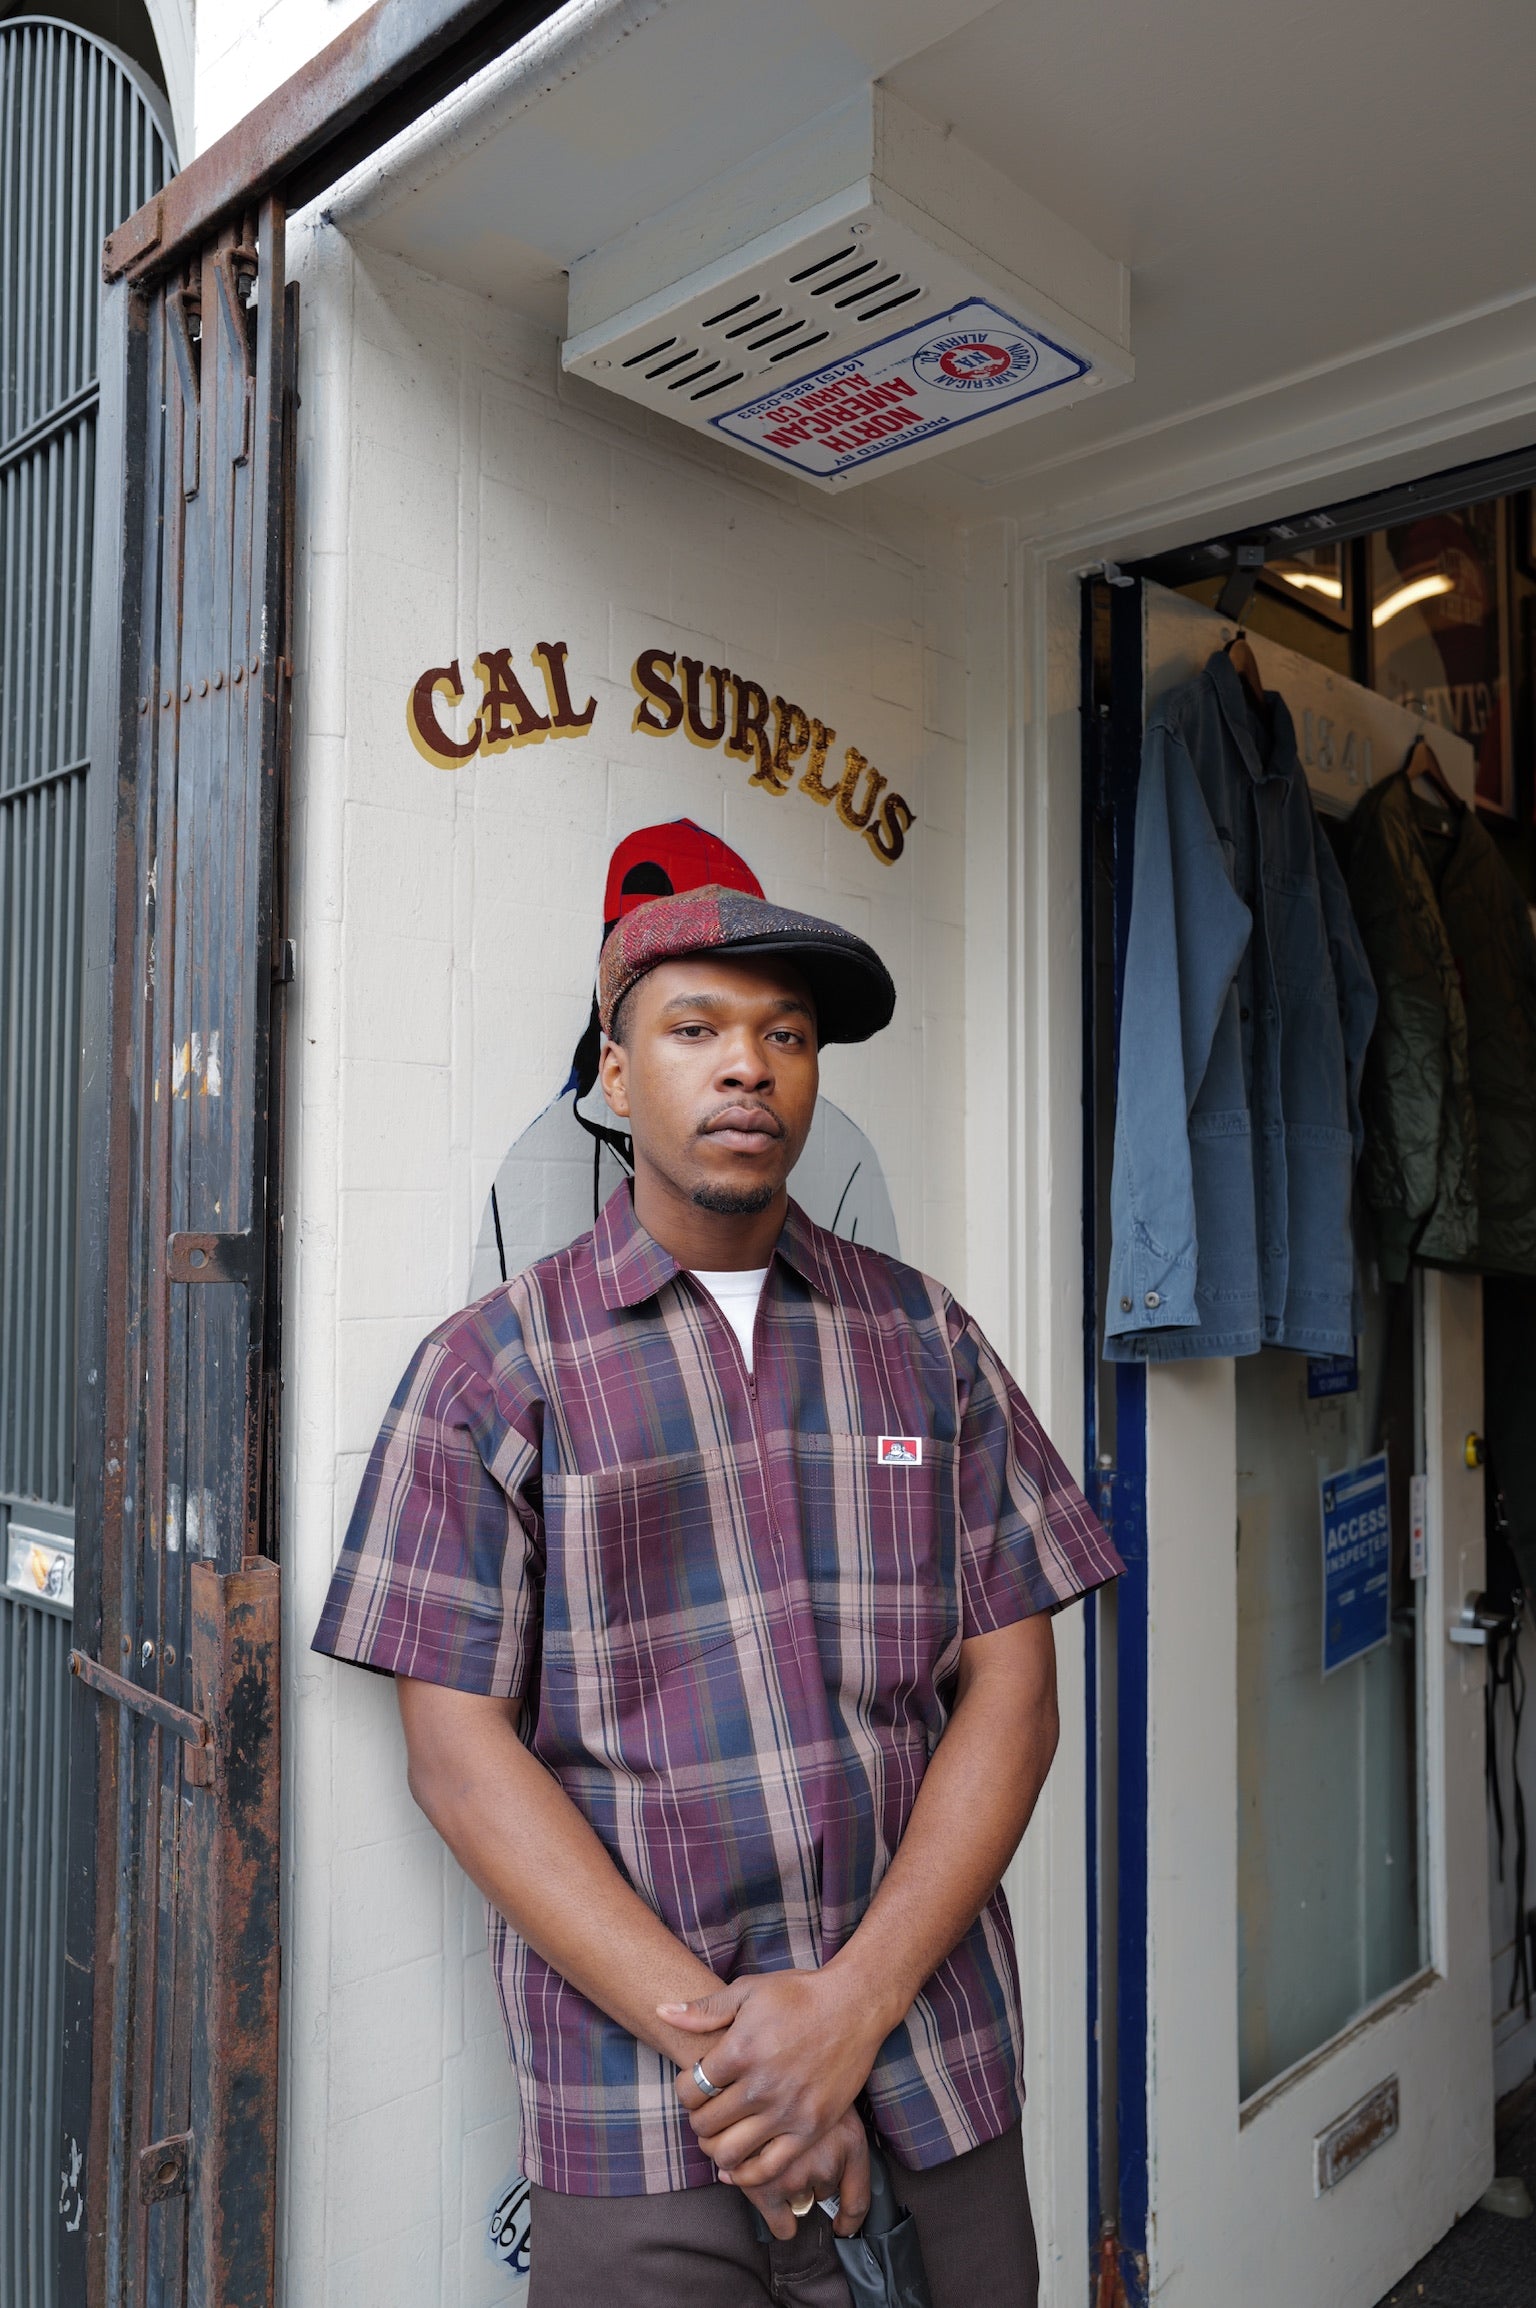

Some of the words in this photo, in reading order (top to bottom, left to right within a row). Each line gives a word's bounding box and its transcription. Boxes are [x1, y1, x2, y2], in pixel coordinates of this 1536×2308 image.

[932, 333, 988, 352] ALARM
[954, 351, 991, 368] NA
[1005, 342, 1031, 371] NORTH
[815, 359, 865, 385] (415)
[933, 370, 1018, 389] AMERICAN
[737, 384, 815, 421] 826-0333
[794, 373, 871, 411] ALARM
[758, 405, 802, 424] CO.
[761, 376, 918, 449] AMERICAN
[817, 405, 925, 454] NORTH
[858, 416, 951, 456] PROTECTED
[834, 454, 856, 466] BY
[405, 641, 598, 771] CAL
[631, 649, 917, 867] SURPLUS
[1303, 708, 1373, 790] 1541
[1326, 1505, 1386, 1553] ACCESS
[1326, 1532, 1388, 1576] INSPECTED
